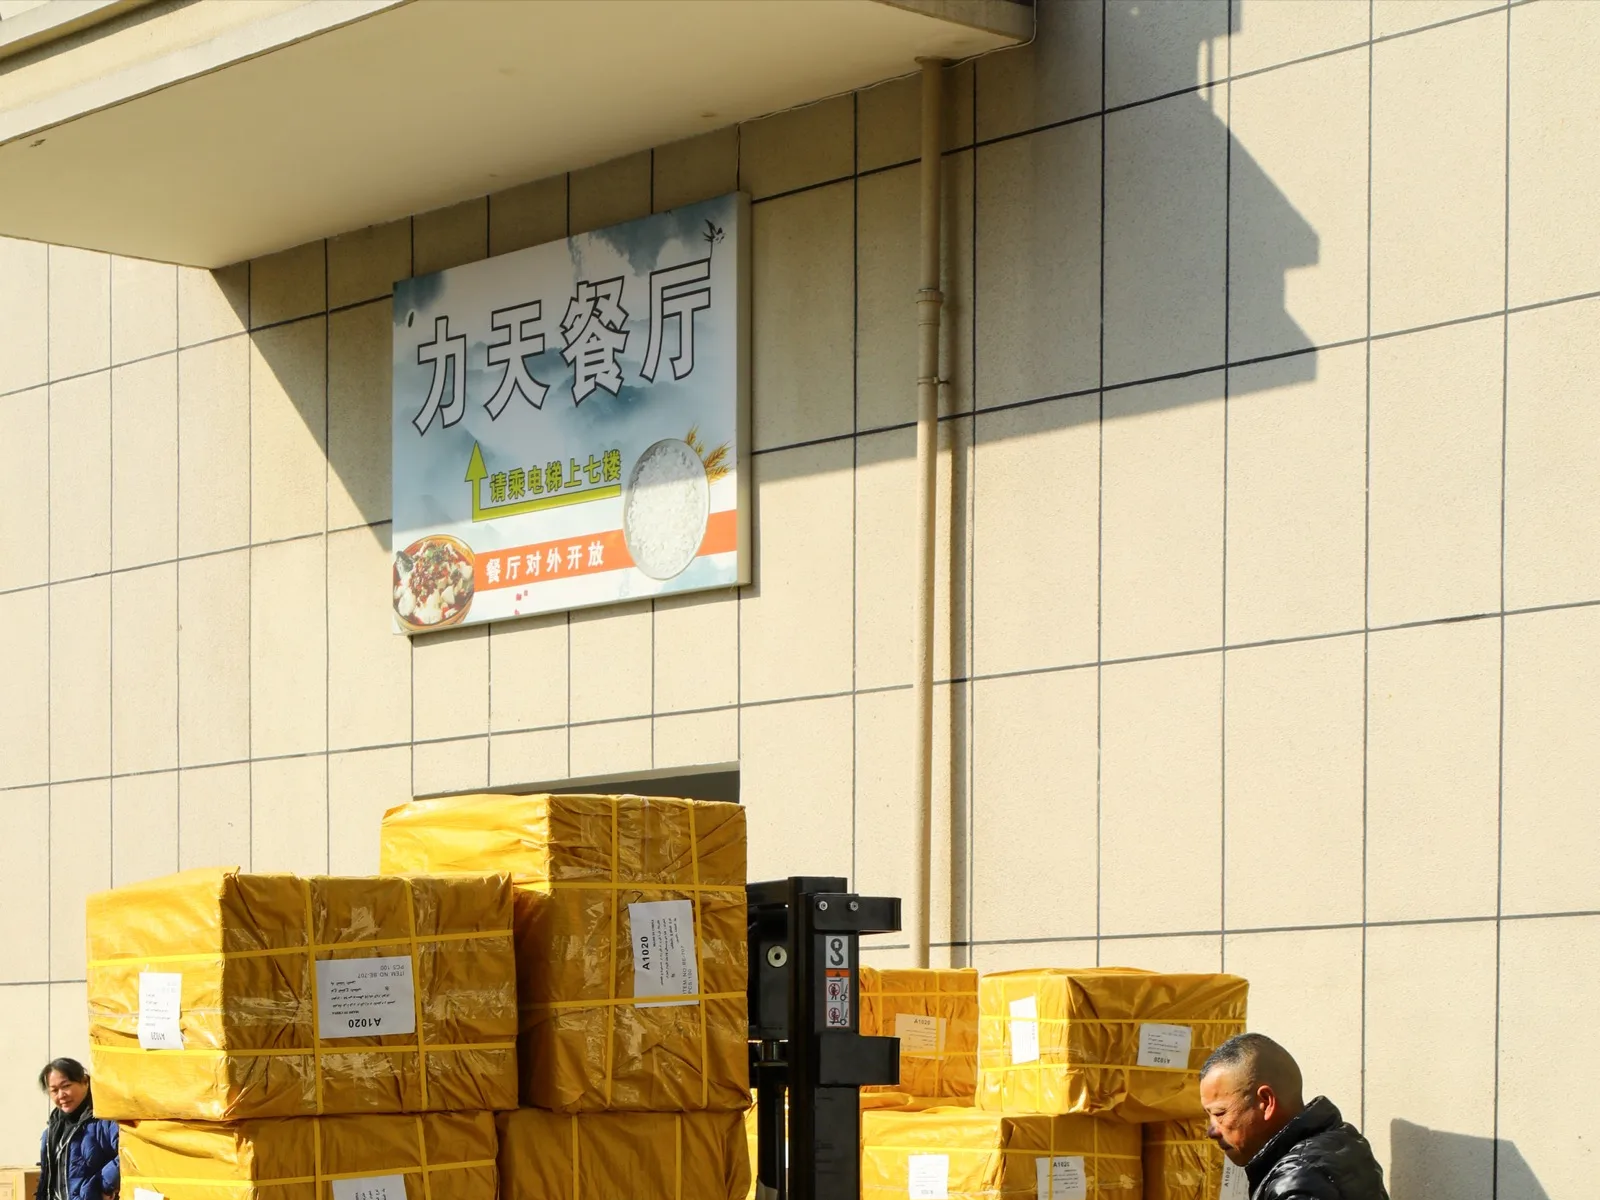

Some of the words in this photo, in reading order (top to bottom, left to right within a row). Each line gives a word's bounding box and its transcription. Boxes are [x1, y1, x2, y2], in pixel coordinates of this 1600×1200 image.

[412, 258, 711, 436] 力天餐厅
[489, 449, 622, 503] 请乘电梯上七楼
[485, 540, 605, 584] 餐厅对外开放
[641, 936, 650, 970] A1020
[348, 1018, 381, 1028] A1020
